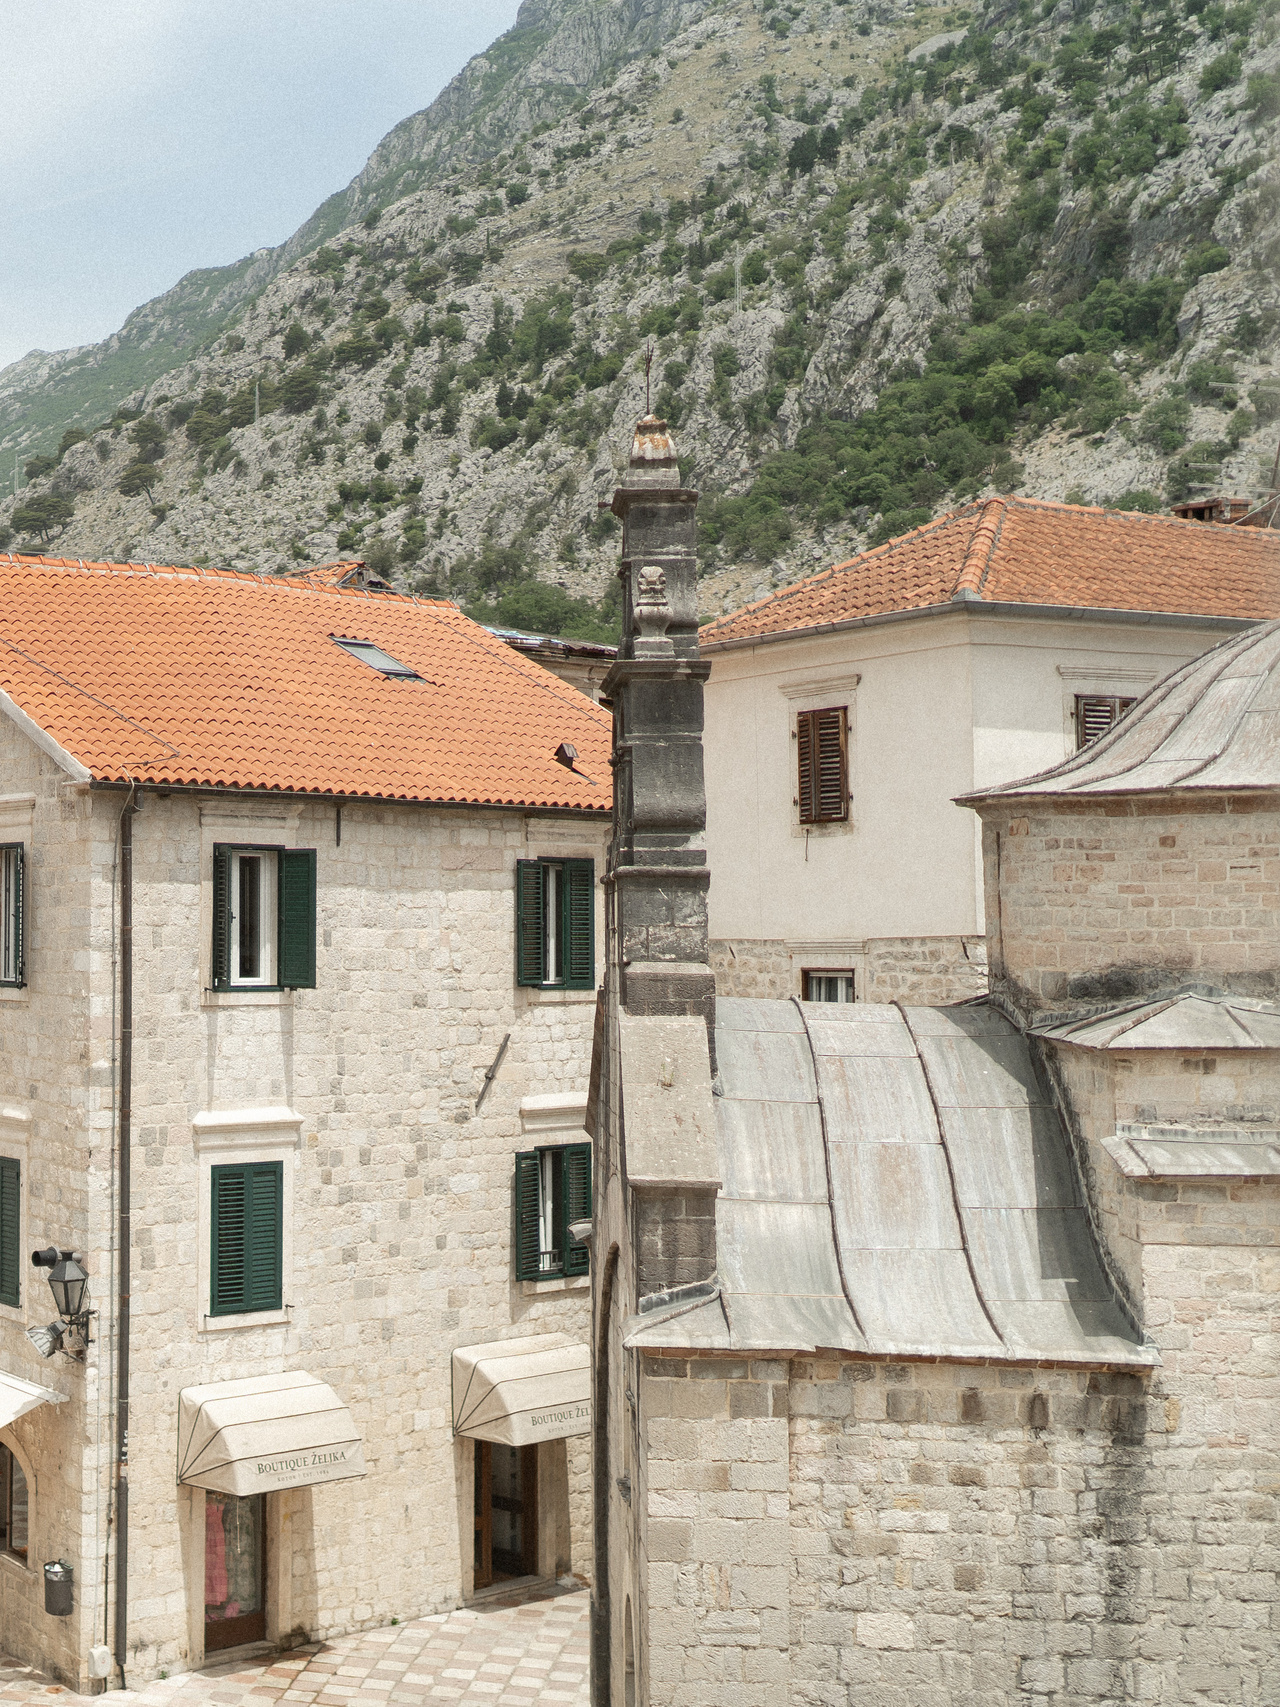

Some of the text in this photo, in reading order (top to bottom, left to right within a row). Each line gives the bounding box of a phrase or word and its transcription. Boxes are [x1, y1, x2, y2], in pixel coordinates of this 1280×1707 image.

[531, 1410, 574, 1426] BOUTIQUE
[575, 1405, 590, 1418] ŽEL
[257, 1451, 347, 1474] BOUTIQUE ŽELJKA
